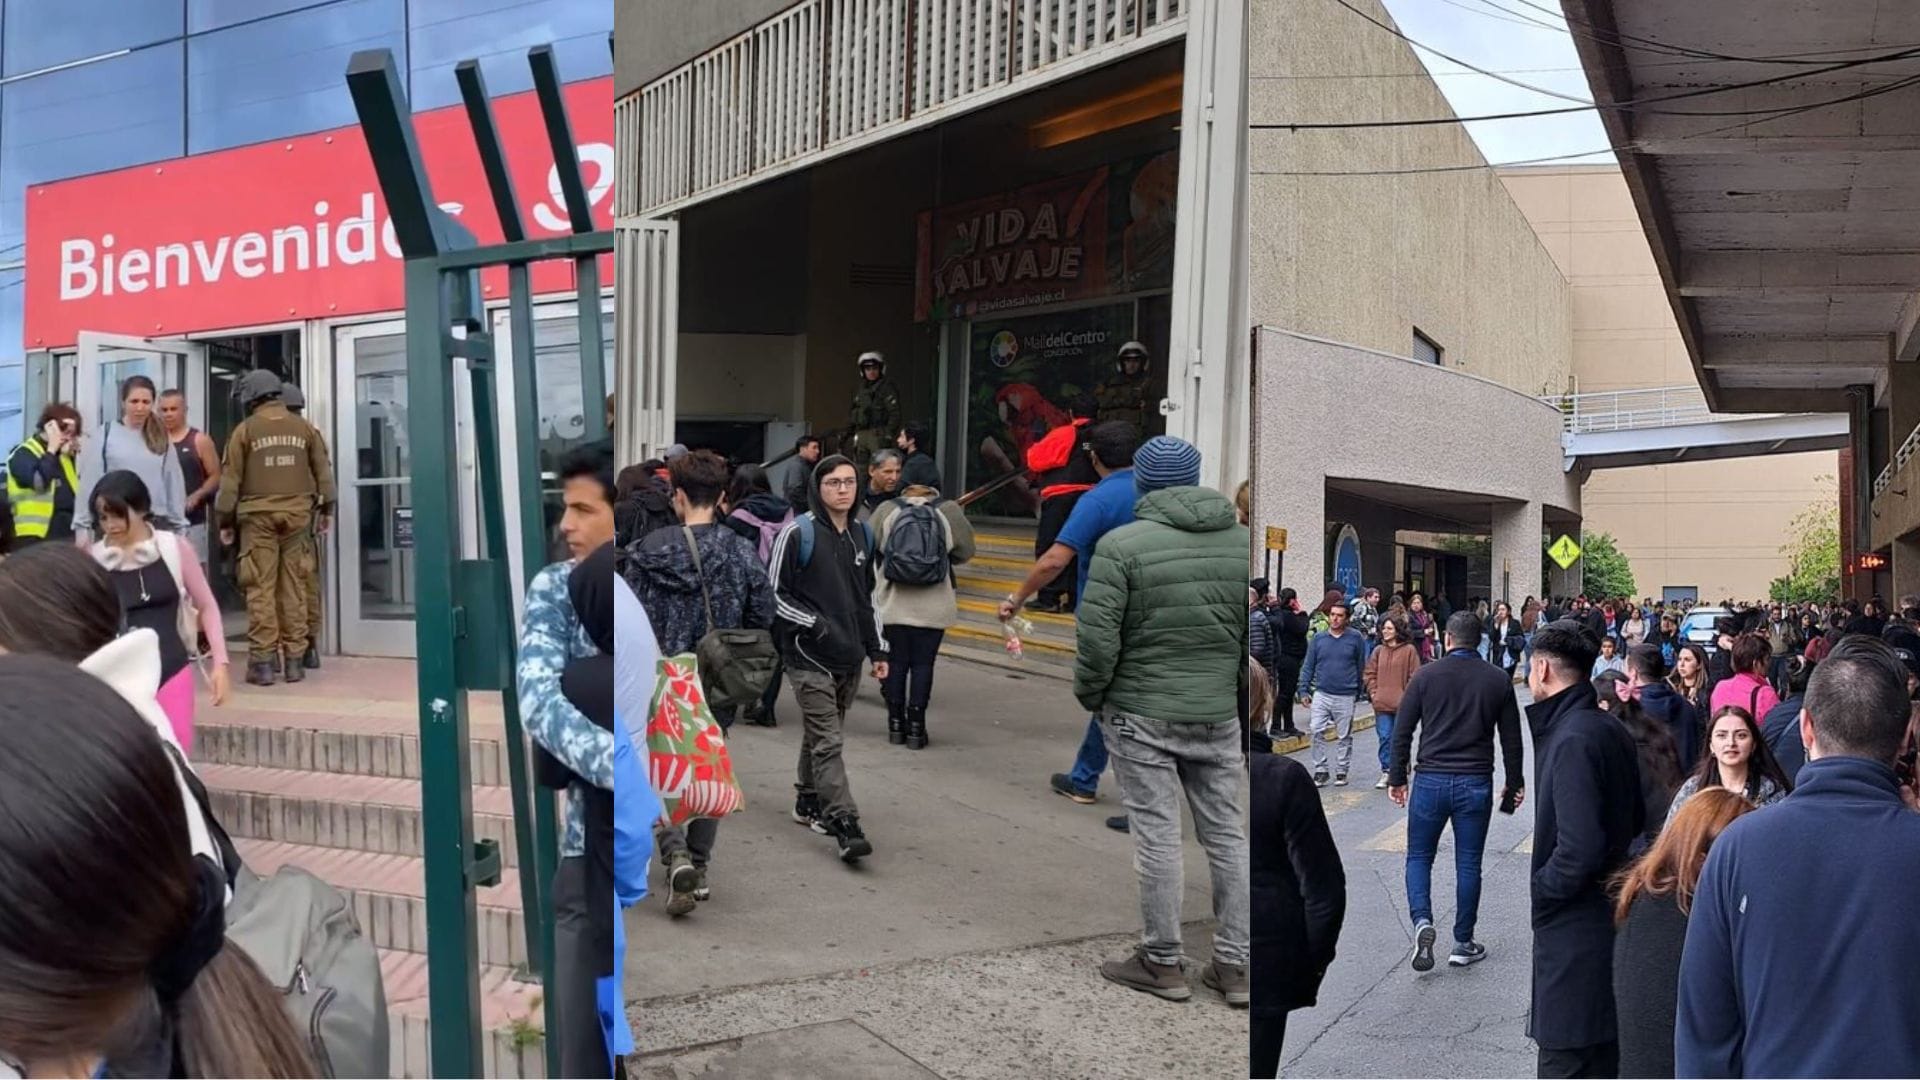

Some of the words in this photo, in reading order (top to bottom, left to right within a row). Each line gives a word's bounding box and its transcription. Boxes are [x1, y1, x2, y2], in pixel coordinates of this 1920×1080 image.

[60, 193, 464, 300] Bienvenido
[957, 203, 1058, 252] VIDA
[933, 246, 1082, 297] SALVAJE
